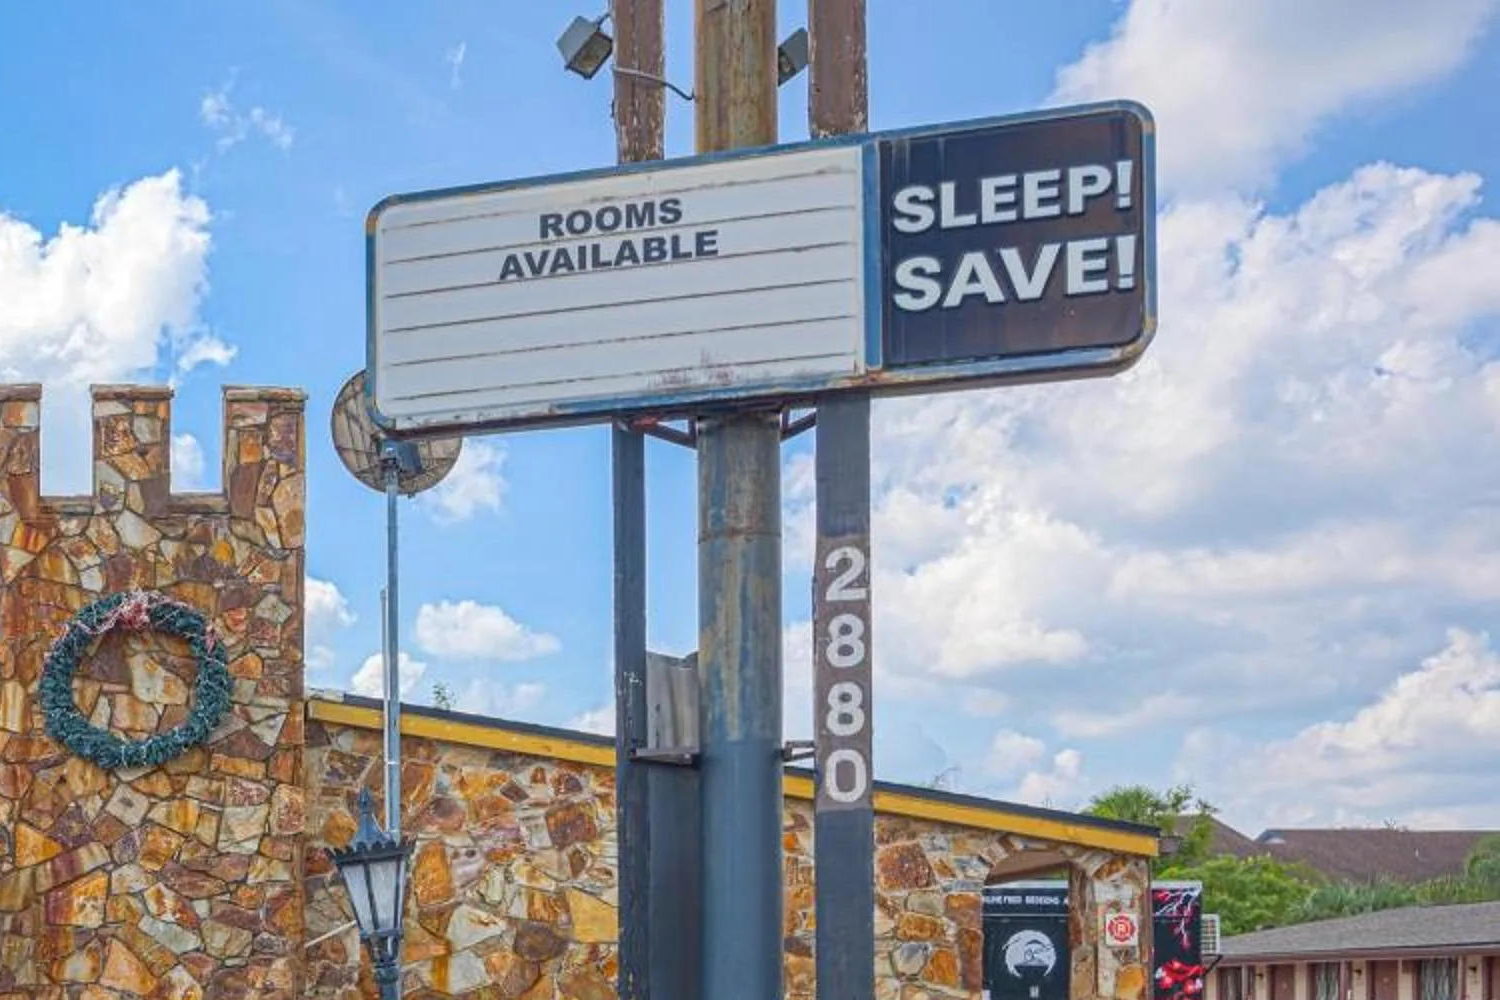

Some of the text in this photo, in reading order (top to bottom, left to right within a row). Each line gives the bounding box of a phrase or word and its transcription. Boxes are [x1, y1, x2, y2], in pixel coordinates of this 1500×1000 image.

[539, 198, 683, 240] ROOMS
[893, 160, 1133, 234] SLEEP!
[499, 229, 719, 281] AVAILABLE
[893, 234, 1137, 312] SAVE!
[825, 545, 868, 803] 2880
